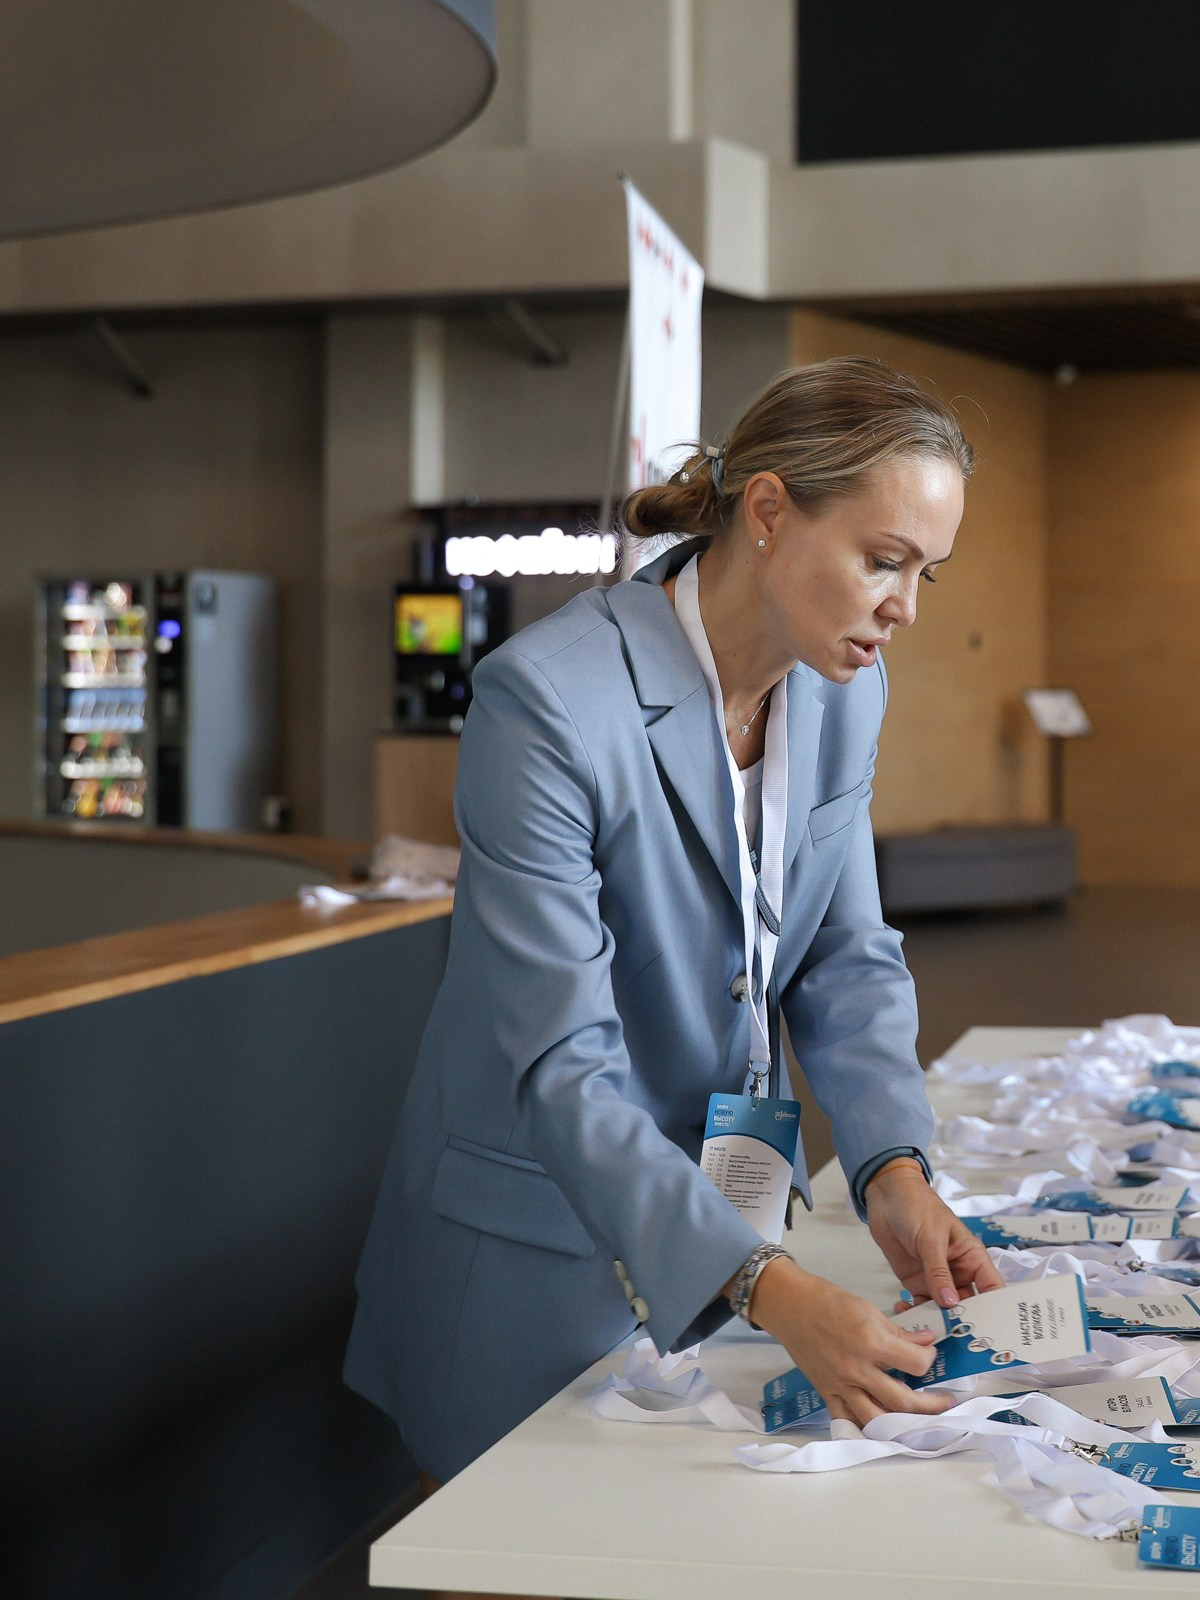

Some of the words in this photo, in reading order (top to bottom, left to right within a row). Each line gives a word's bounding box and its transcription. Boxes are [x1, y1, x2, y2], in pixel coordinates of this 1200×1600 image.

[1017, 1302, 1032, 1346] АНАСТАСИЯ
[1031, 1304, 1044, 1340] ВОЛКОВА
[1118, 1394, 1131, 1413] ВЛАСОВ
[1181, 1534, 1196, 1566] ВЫСОТУ
